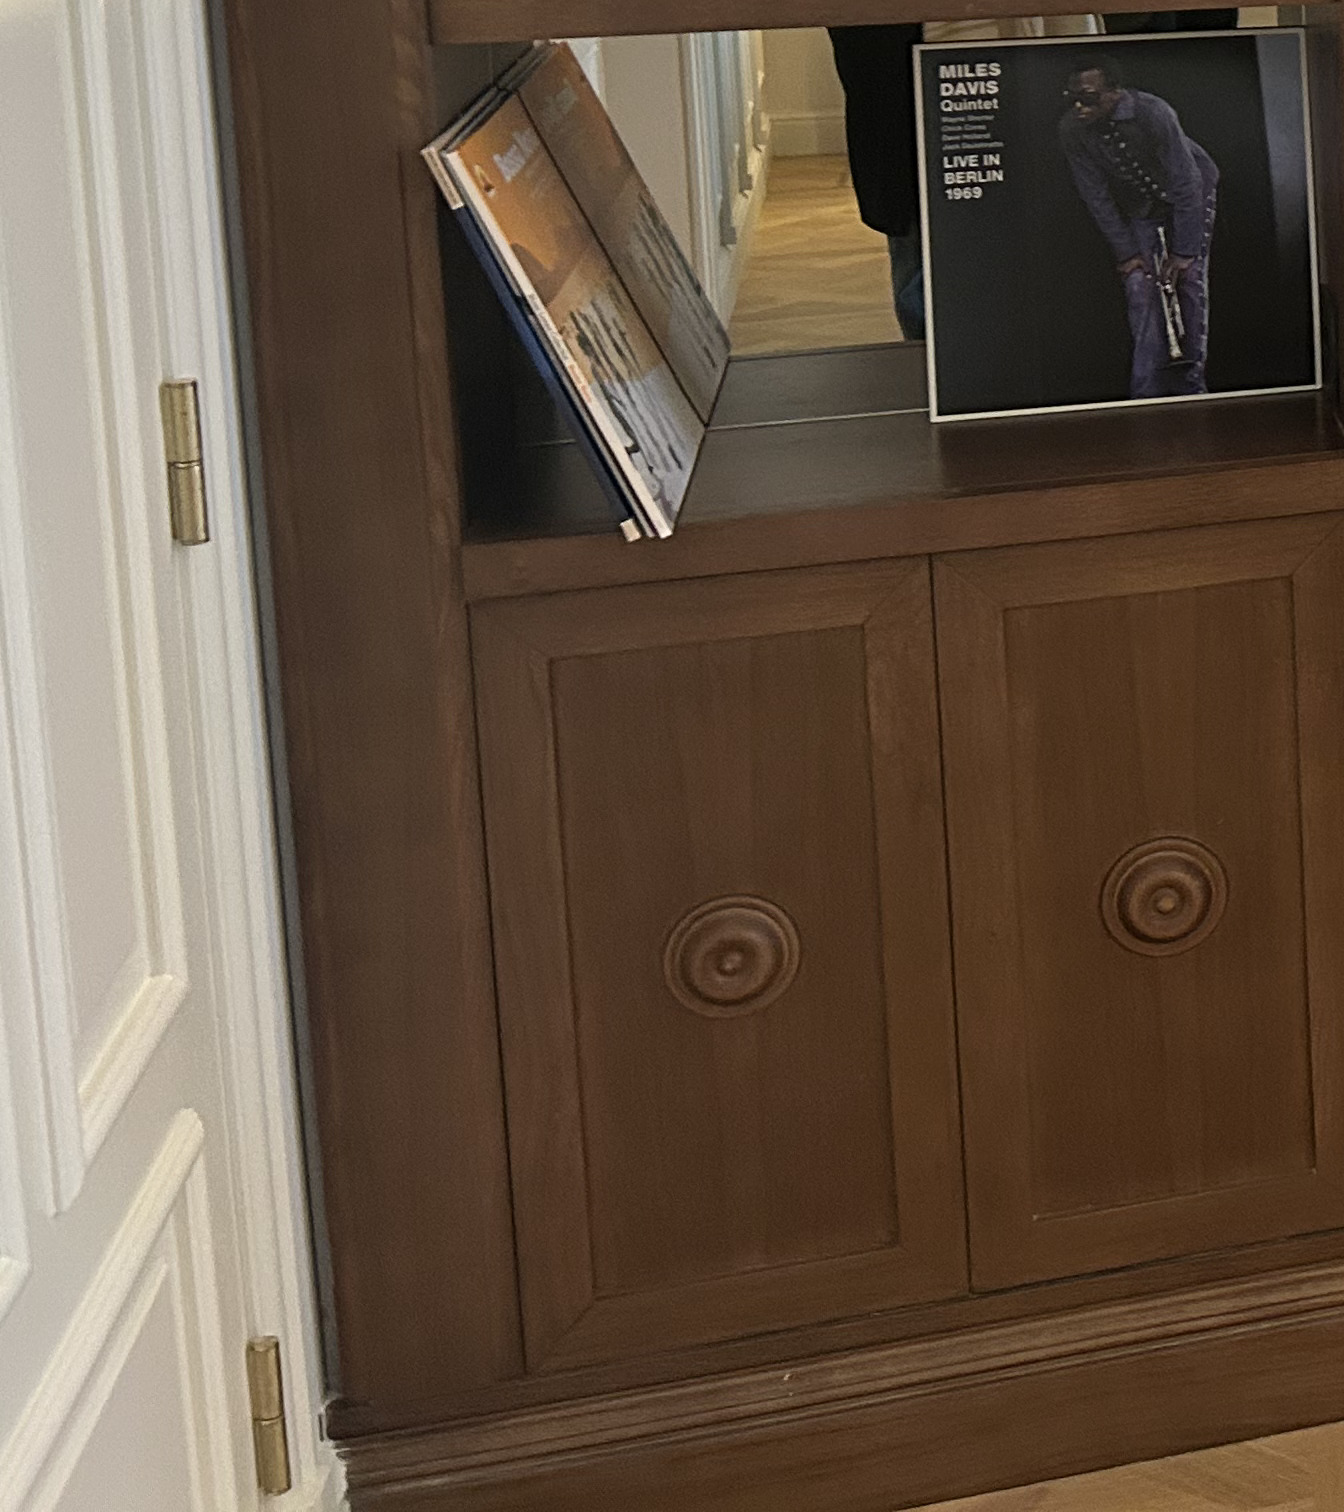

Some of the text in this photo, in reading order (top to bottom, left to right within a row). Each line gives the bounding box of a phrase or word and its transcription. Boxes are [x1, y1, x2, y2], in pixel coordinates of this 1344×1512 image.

[939, 63, 1001, 79] MILES
[940, 80, 999, 96] DAVIS
[940, 98, 999, 112] Quintet
[943, 153, 1001, 169] LIVE IN
[944, 169, 1004, 185] BERLIN
[945, 186, 983, 200] 1969
